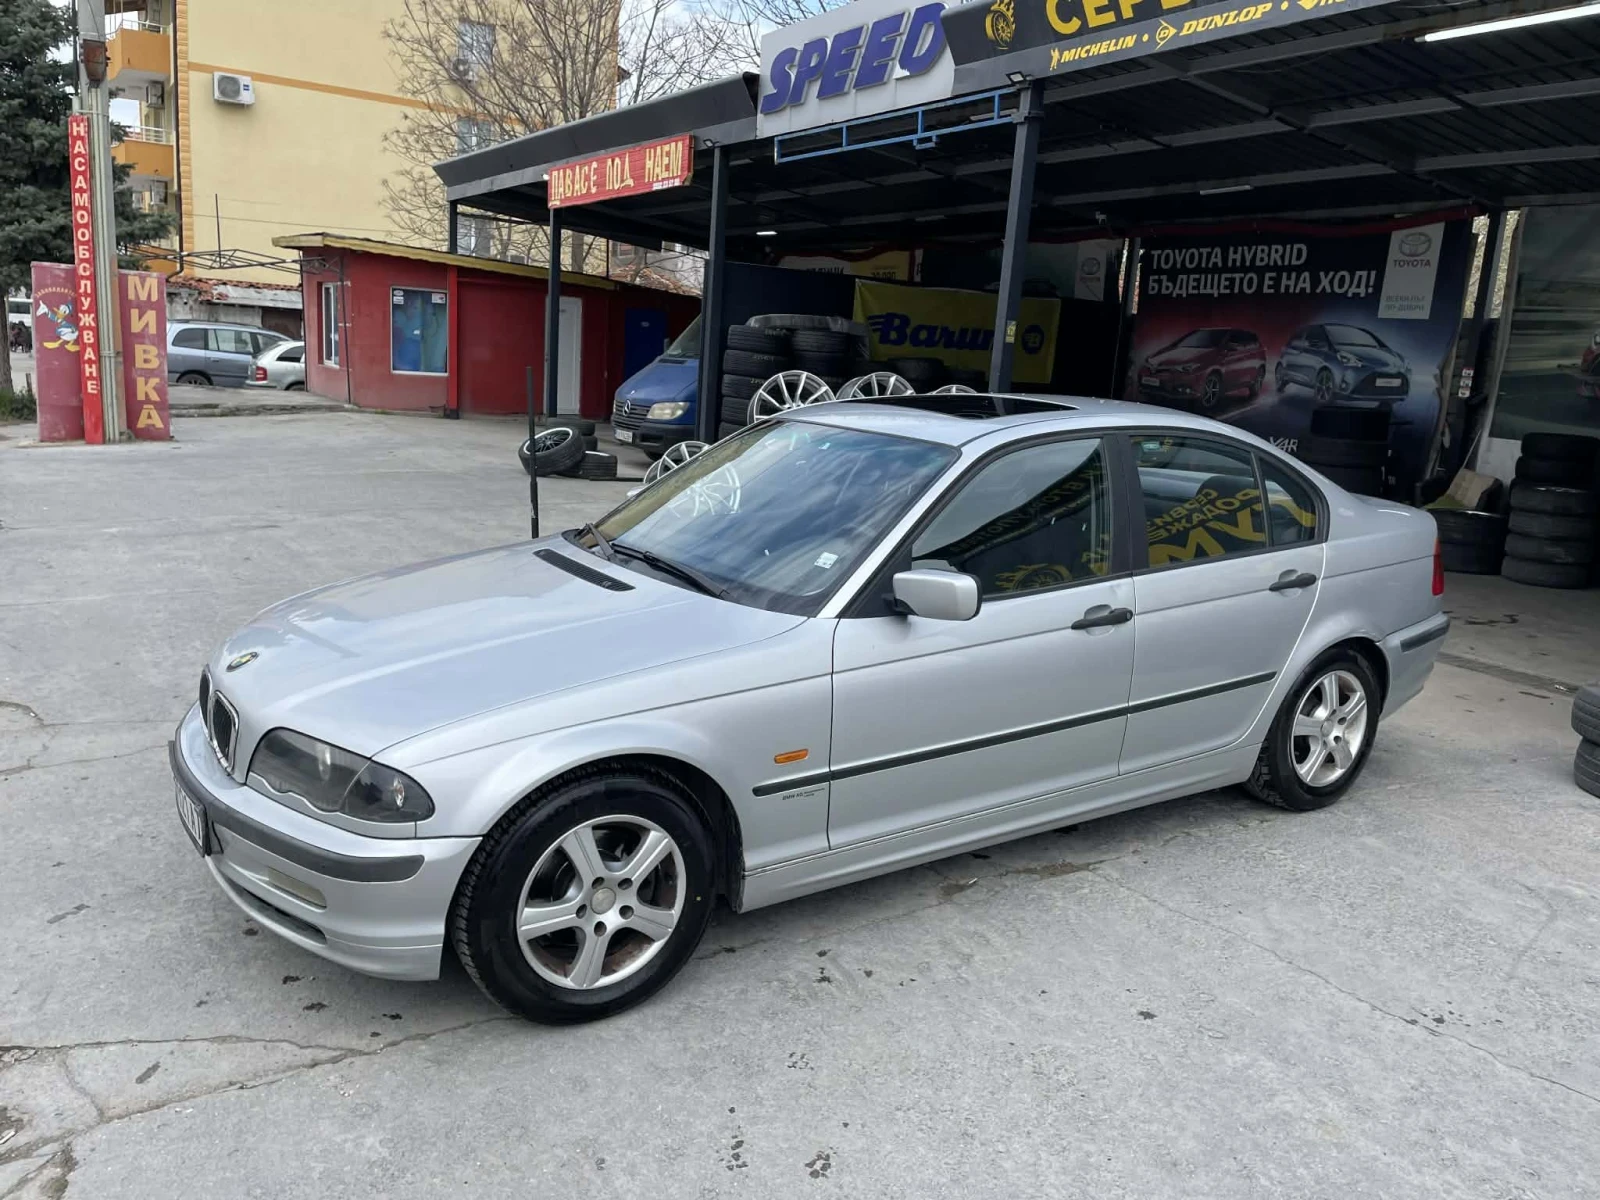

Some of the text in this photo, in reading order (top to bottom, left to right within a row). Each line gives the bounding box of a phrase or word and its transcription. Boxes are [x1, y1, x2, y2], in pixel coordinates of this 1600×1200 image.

[1060, 34, 1138, 63] MICHELIN
[1179, 2, 1273, 36] DUNLOP
[760, 3, 949, 115] SPEED
[606, 152, 635, 190] ПОД
[645, 141, 684, 182] НАЕМ
[1151, 243, 1307, 270] TOYOTA HYBRID
[1393, 258, 1431, 268] TOYOTA
[1148, 269, 1377, 298] БЪДЕЩЕТО Е НА ХОД!
[127, 275, 164, 429] МИВКА
